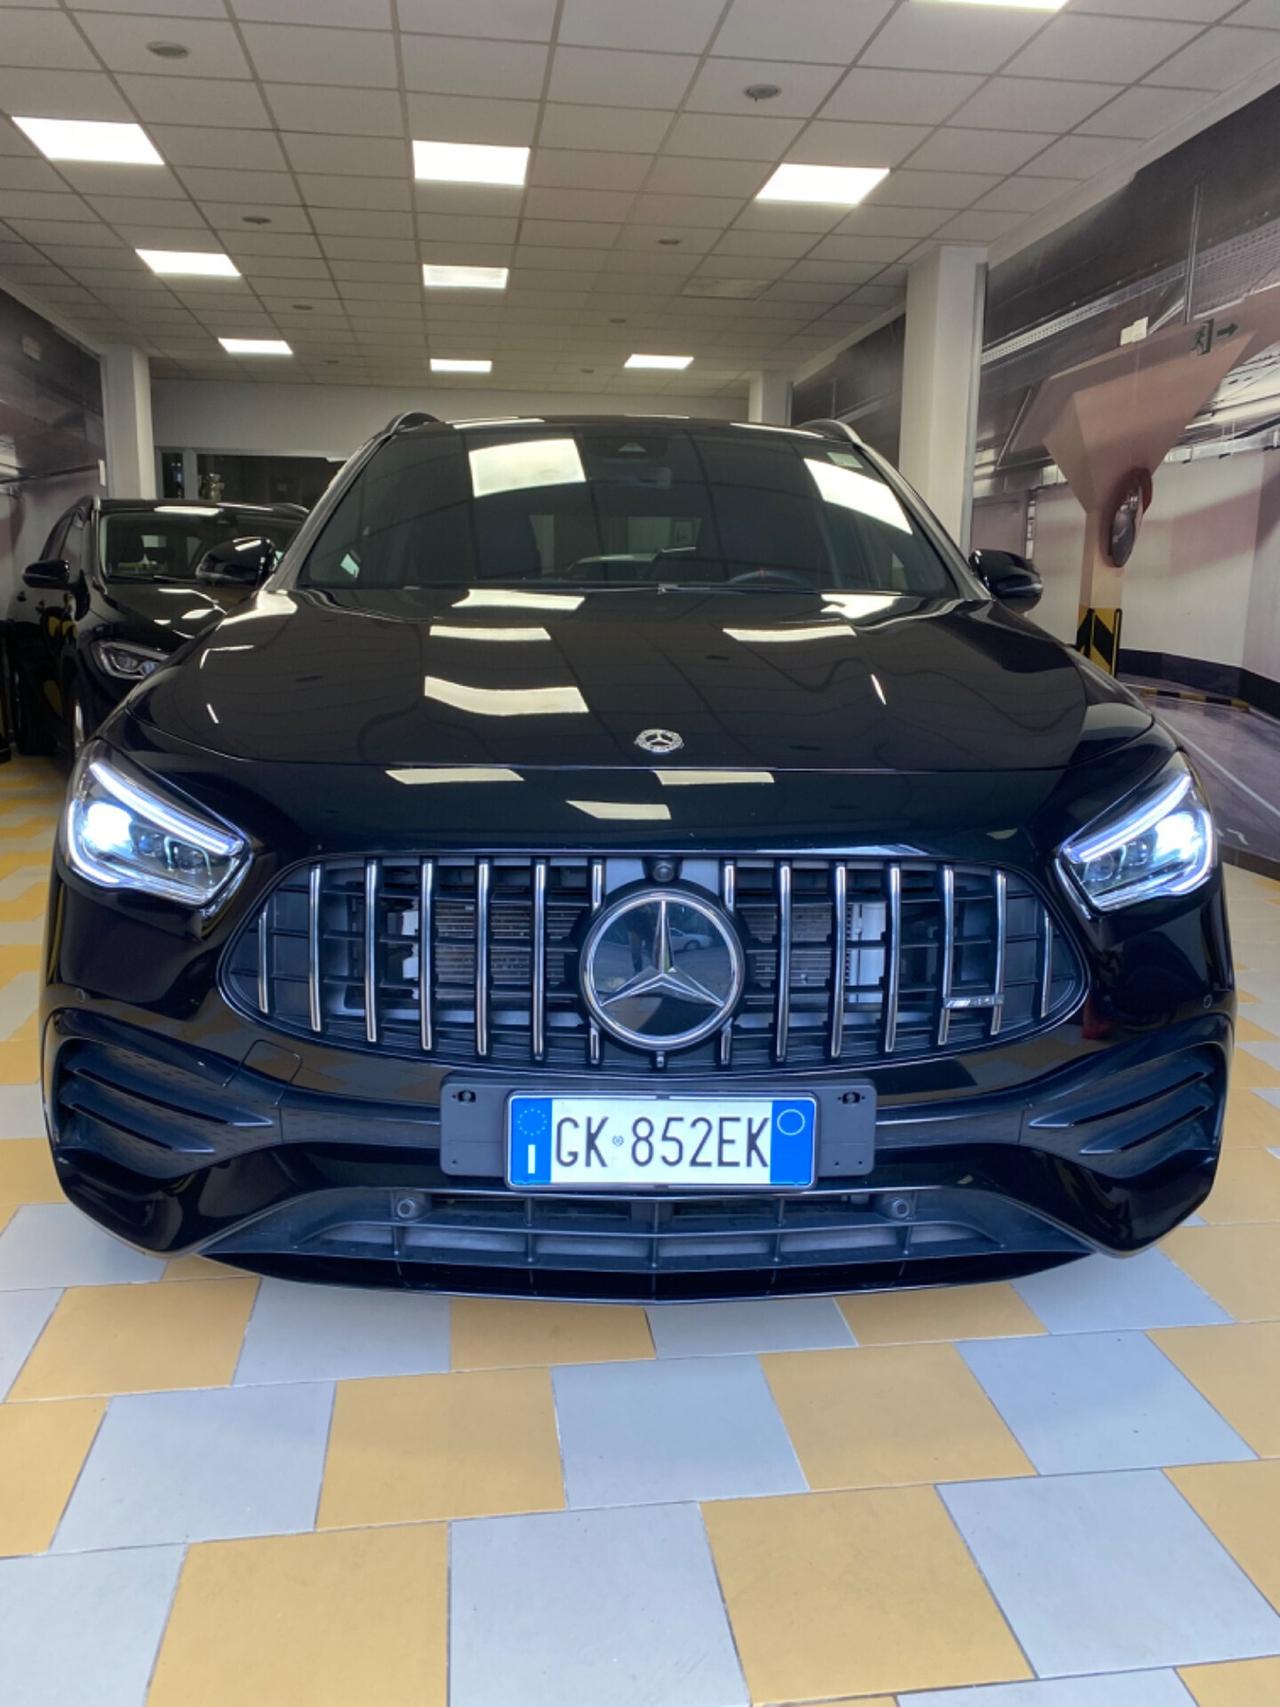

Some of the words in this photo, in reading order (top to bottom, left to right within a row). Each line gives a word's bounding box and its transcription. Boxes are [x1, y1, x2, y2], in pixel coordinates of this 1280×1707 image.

[527, 1144, 536, 1174] I
[556, 1116, 609, 1168] GK
[630, 1116, 770, 1168] 852EK
